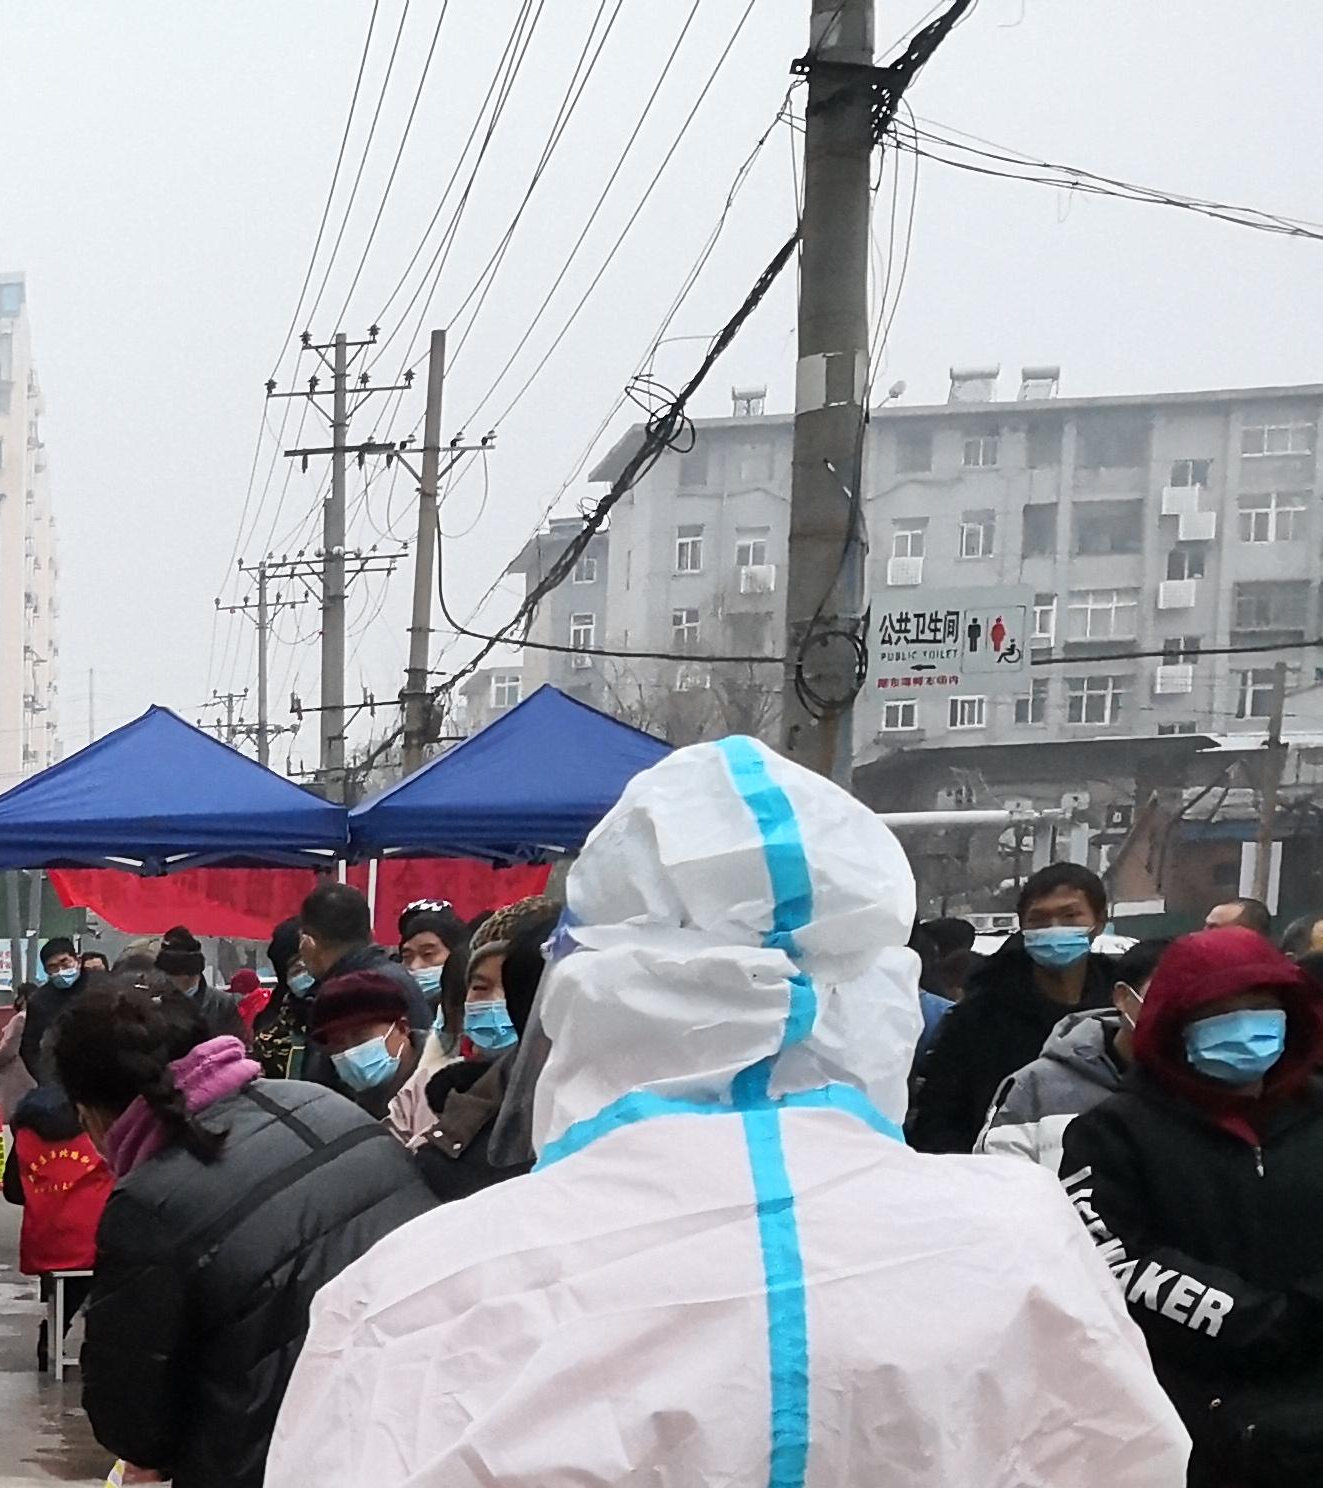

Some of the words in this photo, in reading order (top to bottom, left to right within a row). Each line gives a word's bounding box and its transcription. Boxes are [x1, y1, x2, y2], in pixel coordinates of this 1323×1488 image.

[879, 610, 960, 646] 公共卫生间
[881, 650, 916, 662] PUBLIC
[922, 649, 958, 660] TOILET
